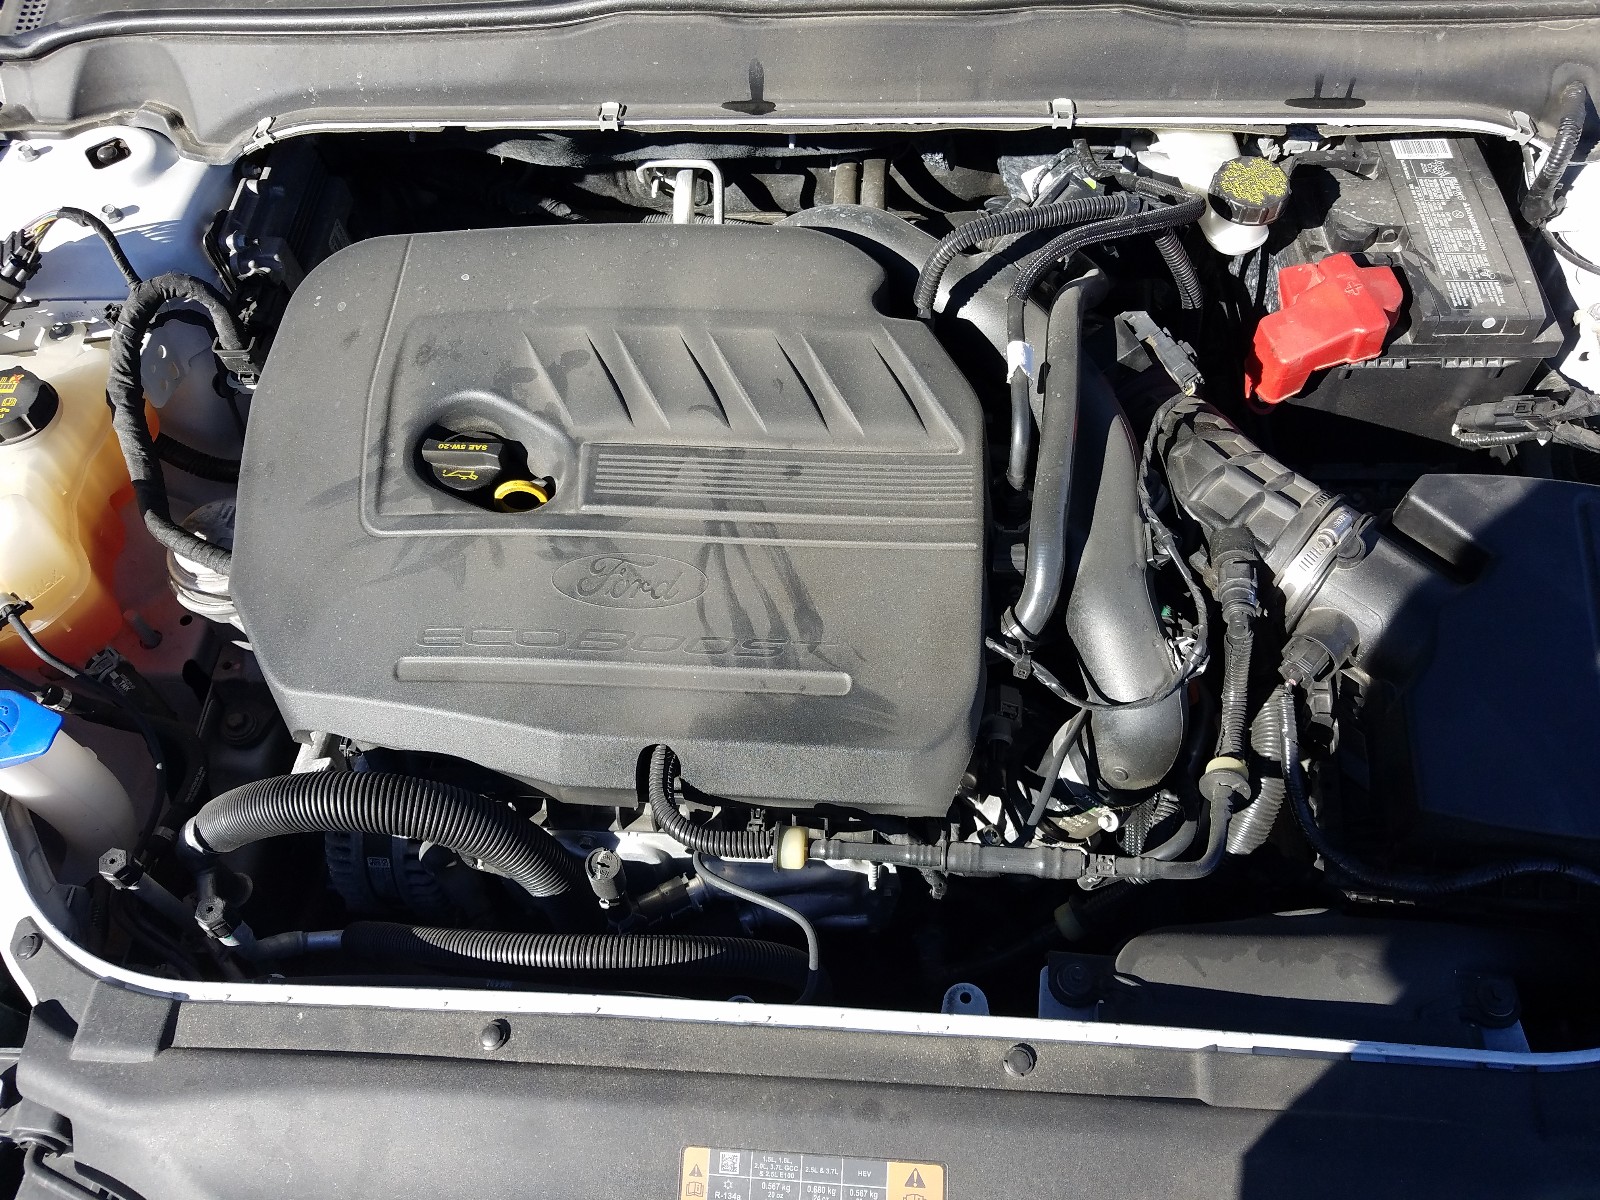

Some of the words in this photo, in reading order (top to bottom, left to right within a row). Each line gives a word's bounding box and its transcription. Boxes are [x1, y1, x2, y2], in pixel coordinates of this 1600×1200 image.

[576, 556, 682, 601] Ford
[761, 1181, 781, 1191] 0.567
[781, 1184, 791, 1193] kg
[806, 1185, 826, 1194] 0.680
[827, 1186, 837, 1196] kg
[714, 1191, 741, 1200] R-134a
[849, 1189, 868, 1197] 0.567
[869, 1190, 879, 1200] kg
